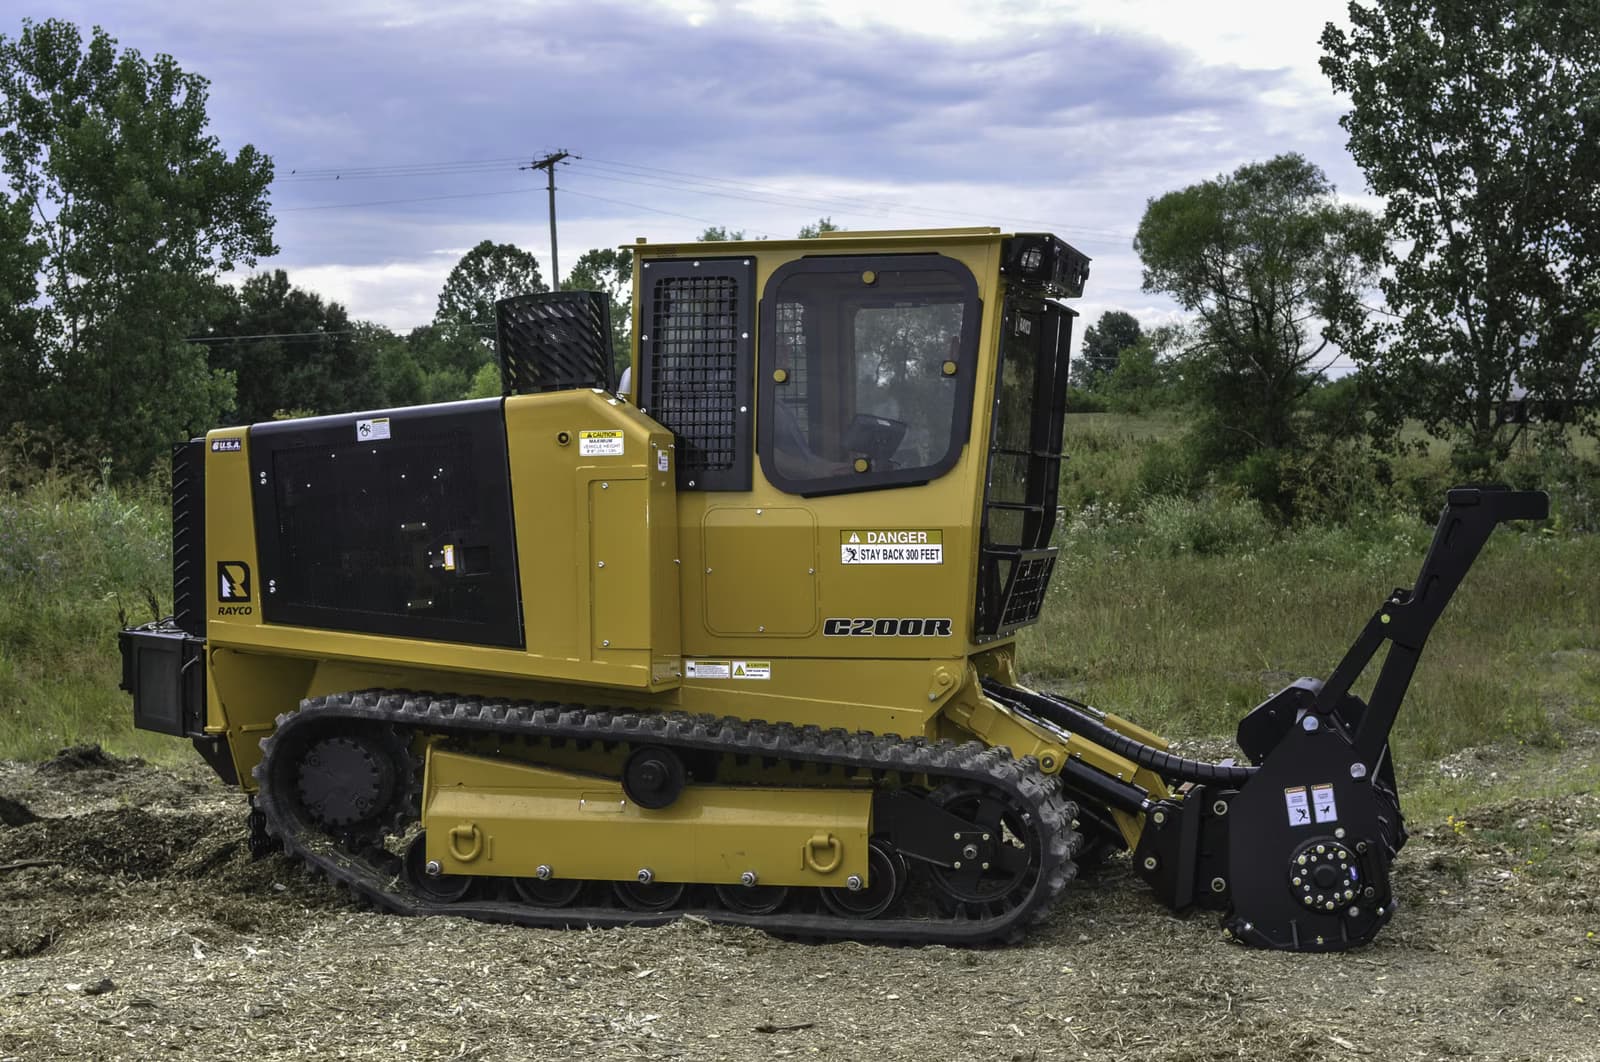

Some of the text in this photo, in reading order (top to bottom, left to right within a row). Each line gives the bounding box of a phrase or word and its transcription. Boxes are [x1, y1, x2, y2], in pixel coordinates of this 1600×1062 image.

[867, 531, 928, 544] DANGER
[860, 548, 940, 561] STAY BACK 300 FEET
[217, 606, 253, 616] RAYCO
[822, 617, 953, 637] C200R
